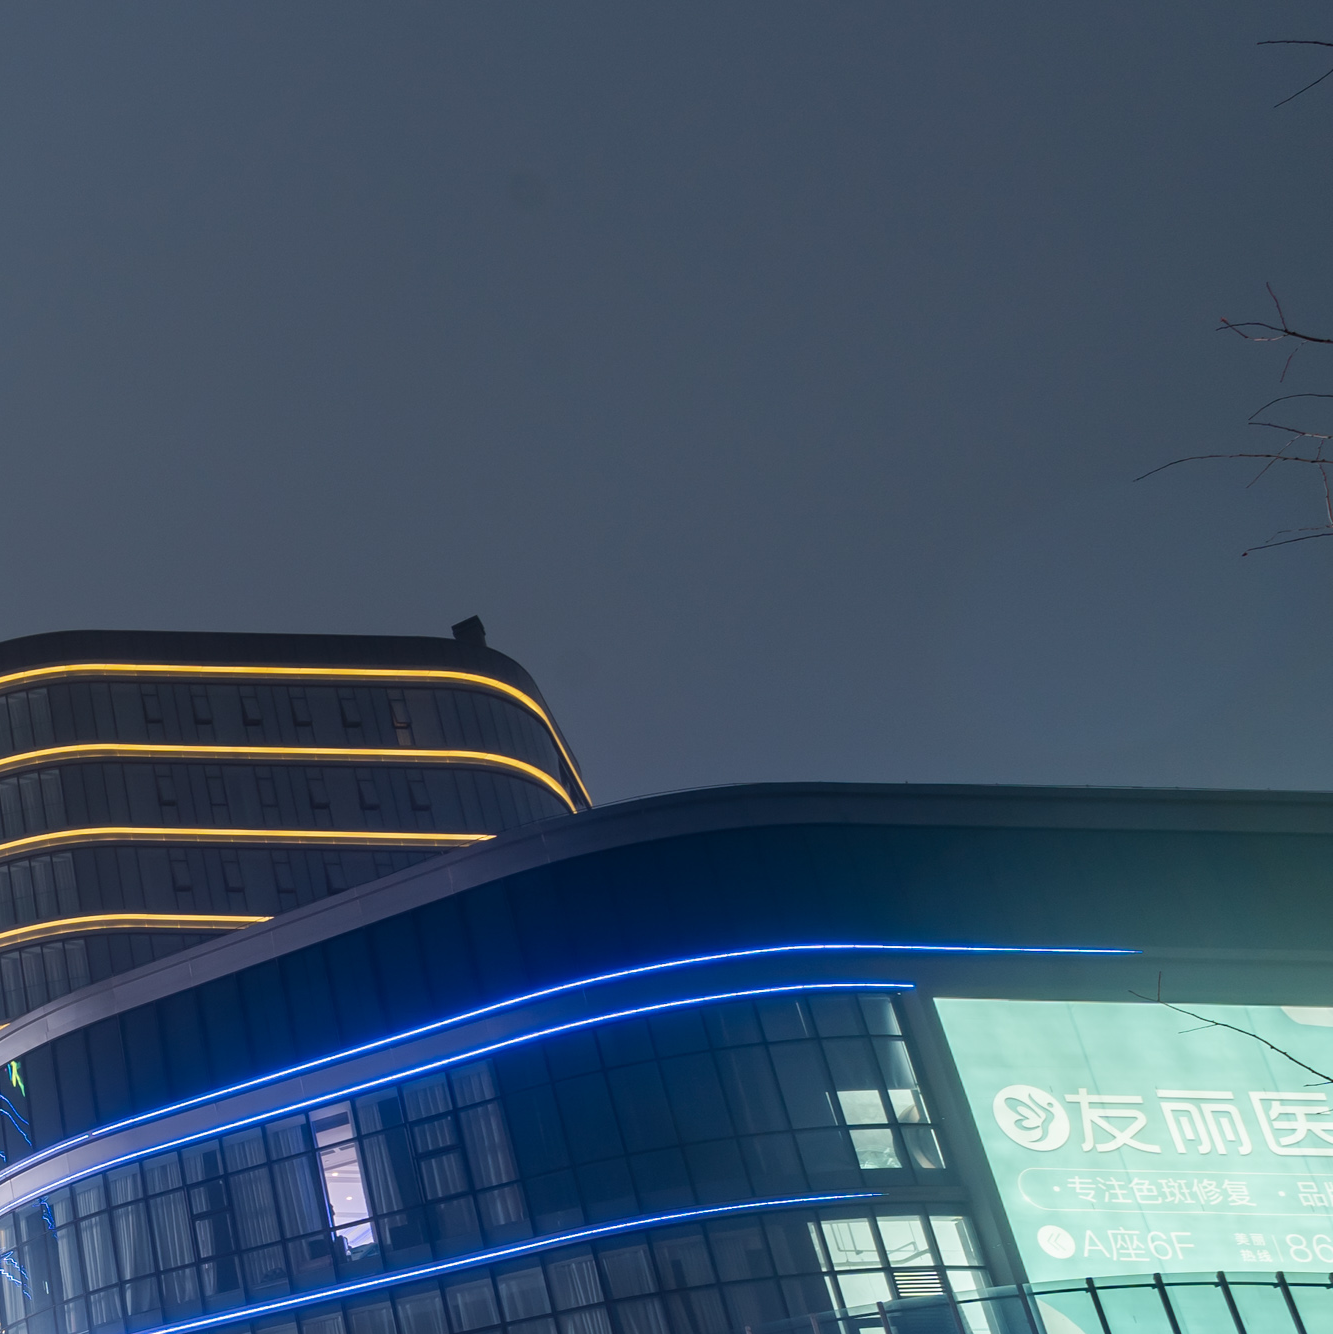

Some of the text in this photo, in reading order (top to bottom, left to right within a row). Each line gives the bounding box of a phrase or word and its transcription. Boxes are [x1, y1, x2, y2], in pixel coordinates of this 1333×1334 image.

[1066, 1175, 1257, 1207] 专注色斑修复
[1083, 1226, 1195, 1262] A座6F
